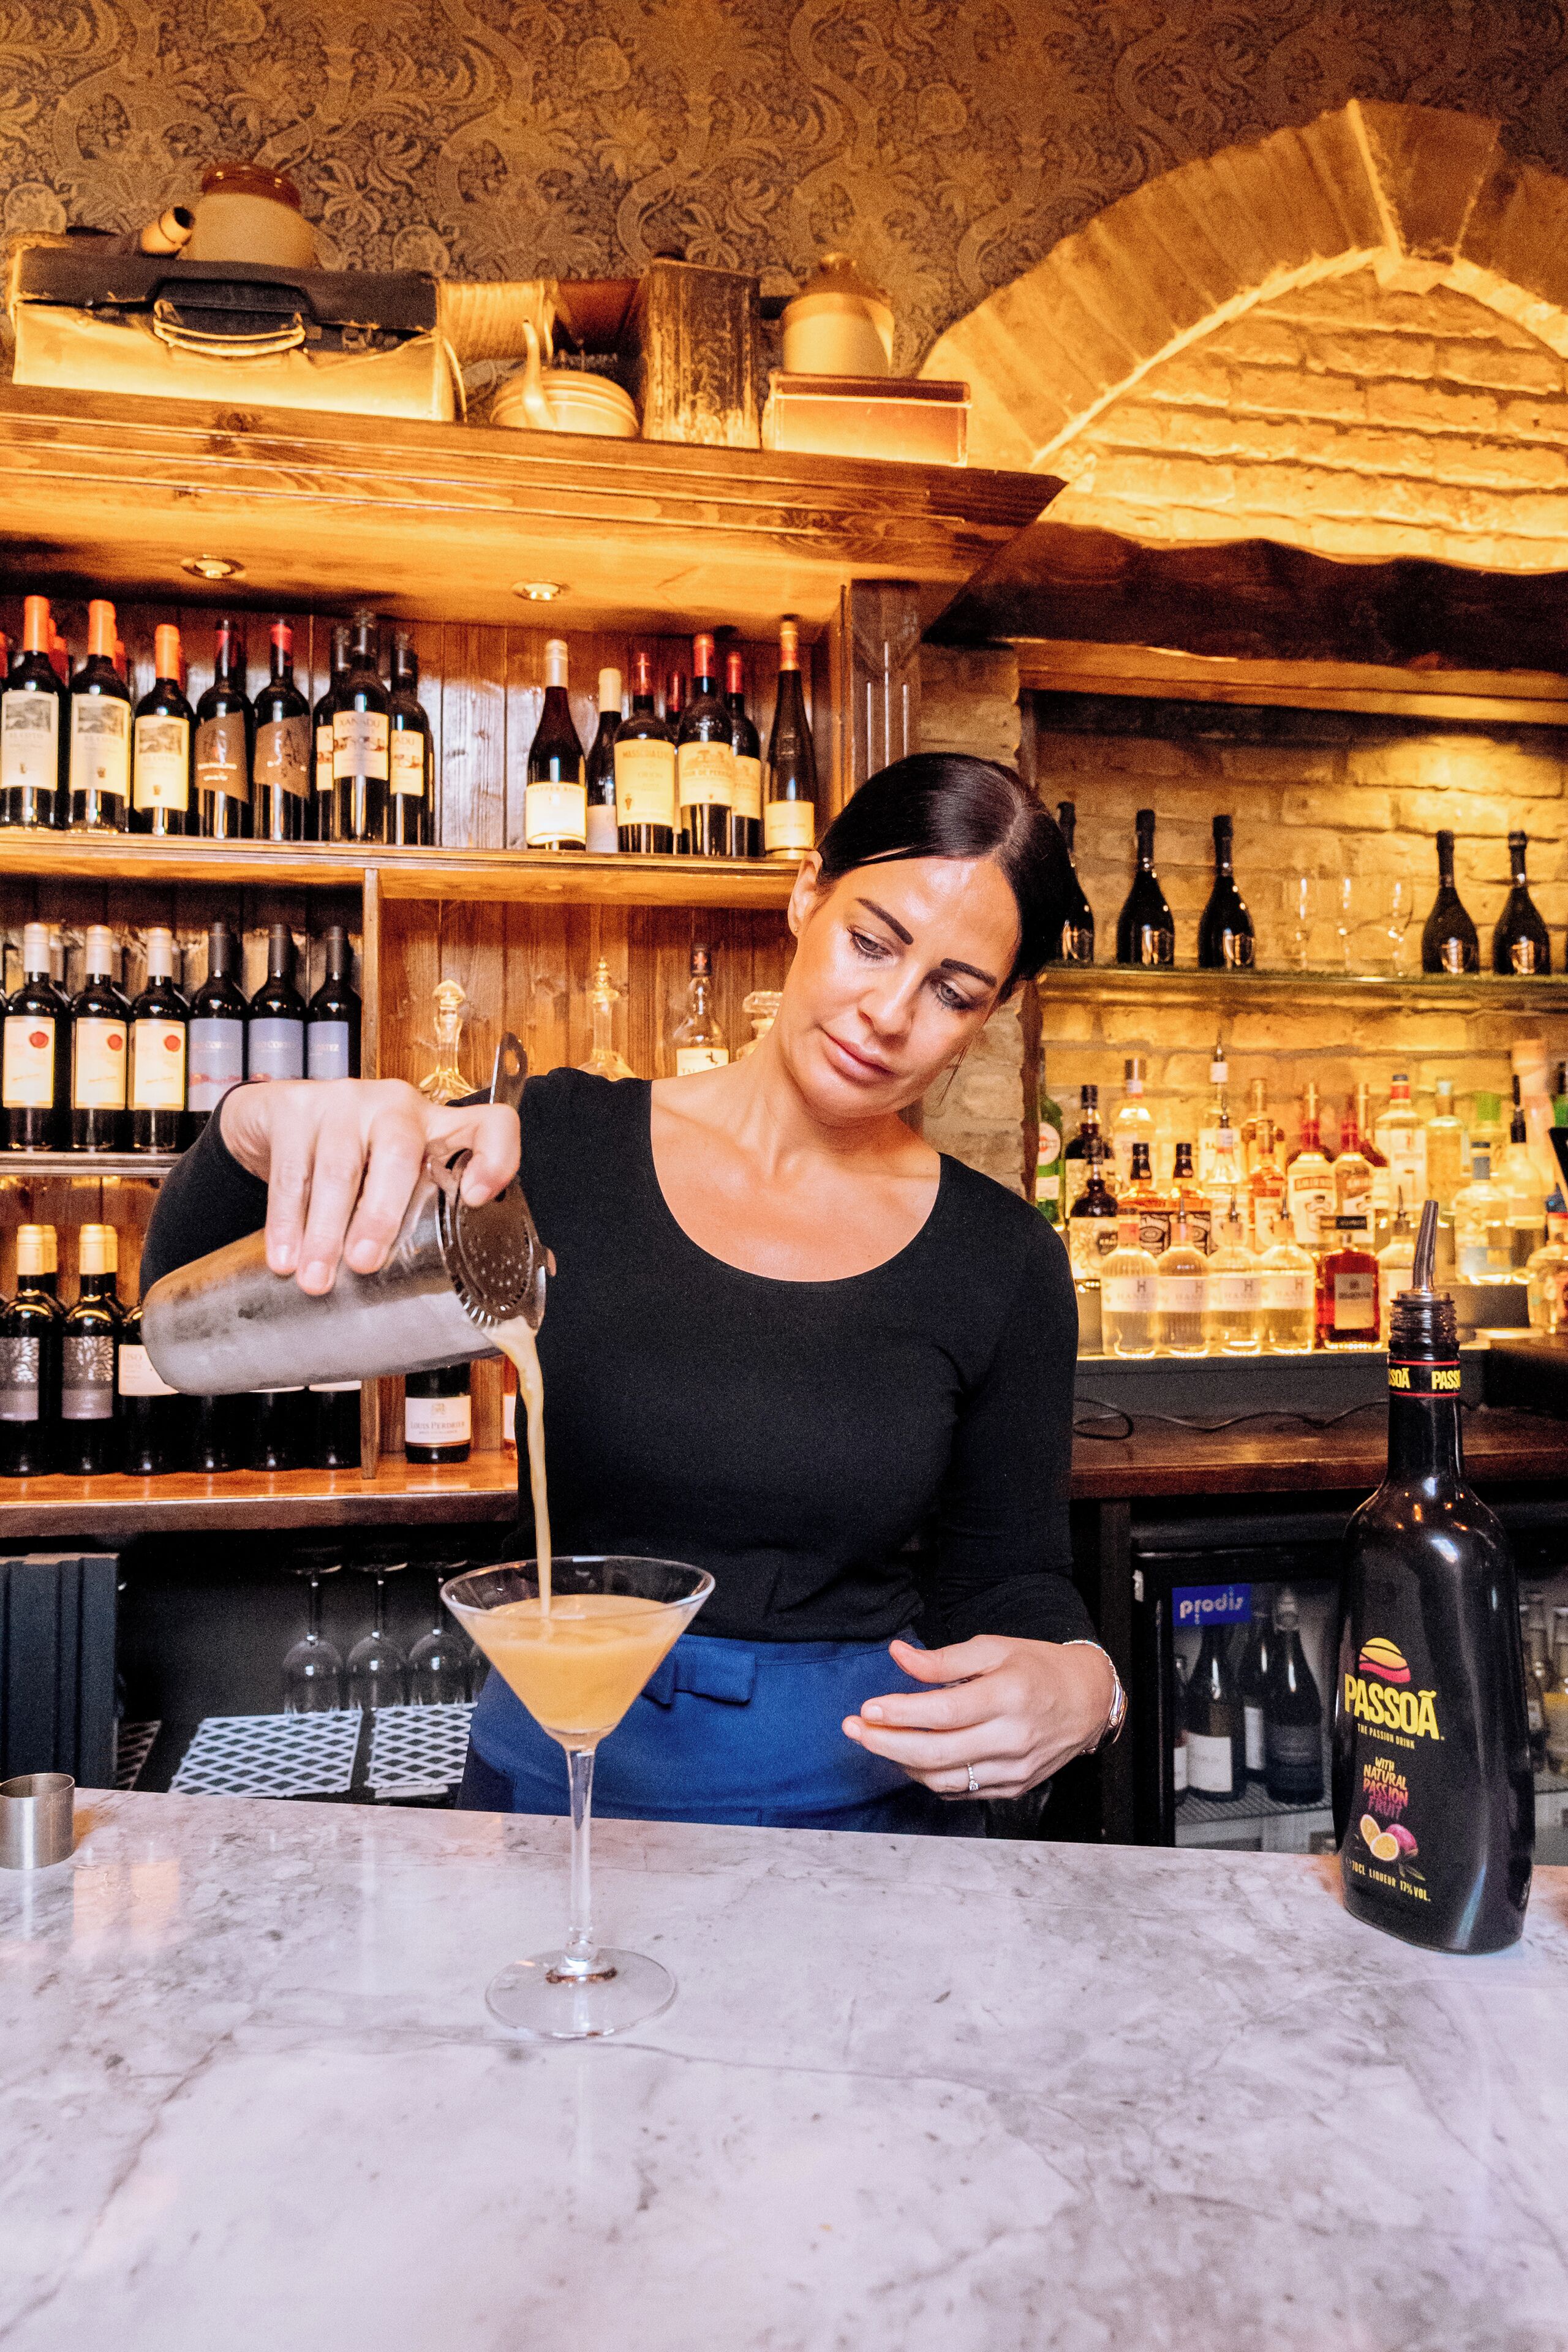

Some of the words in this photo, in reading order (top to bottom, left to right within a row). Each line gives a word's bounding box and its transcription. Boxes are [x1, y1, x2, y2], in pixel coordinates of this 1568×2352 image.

[1137, 1280, 1146, 1292] H
[1245, 1279, 1253, 1292] H
[1344, 1673, 1440, 1741] PASSOÃ
[1357, 1723, 1368, 1735] THE
[1370, 1727, 1394, 1744] PASSION
[1395, 1736, 1415, 1750] DRINK
[1374, 1756, 1395, 1772] WITH
[1363, 1764, 1408, 1791] NATURAL
[1363, 1777, 1409, 1807] PASSION
[1368, 1795, 1403, 1820] FRUIT
[1369, 1869, 1396, 1888] LIQUEUR
